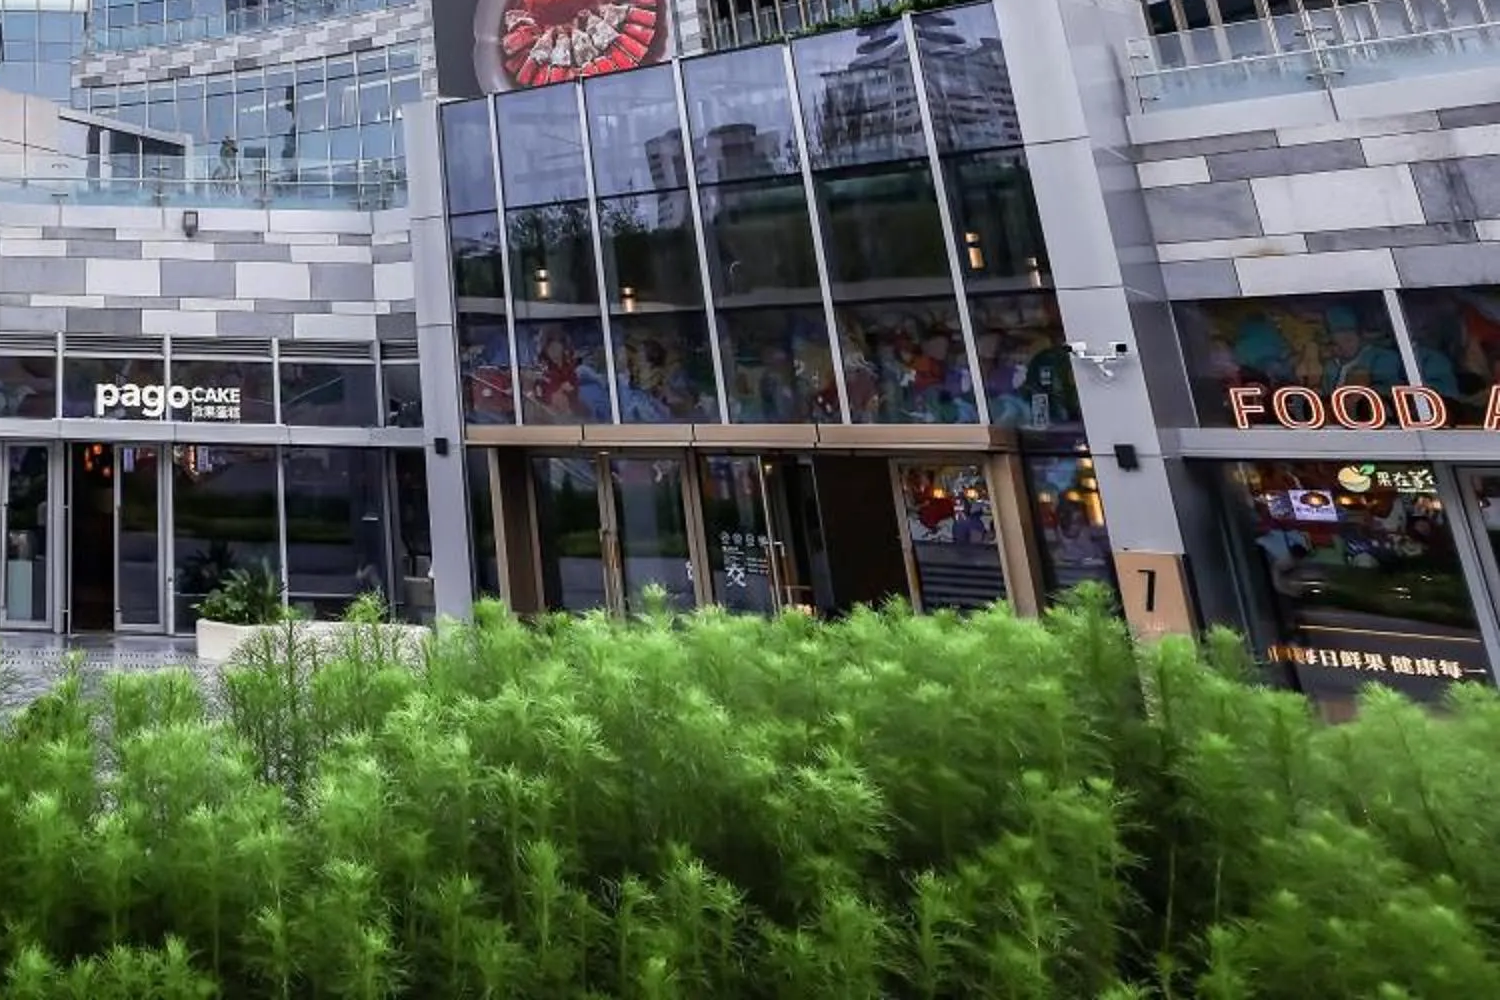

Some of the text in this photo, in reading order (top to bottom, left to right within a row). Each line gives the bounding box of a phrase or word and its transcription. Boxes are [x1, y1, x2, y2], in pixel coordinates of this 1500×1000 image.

[95, 383, 241, 417] pago CAKE
[1229, 385, 1447, 431] FOOD
